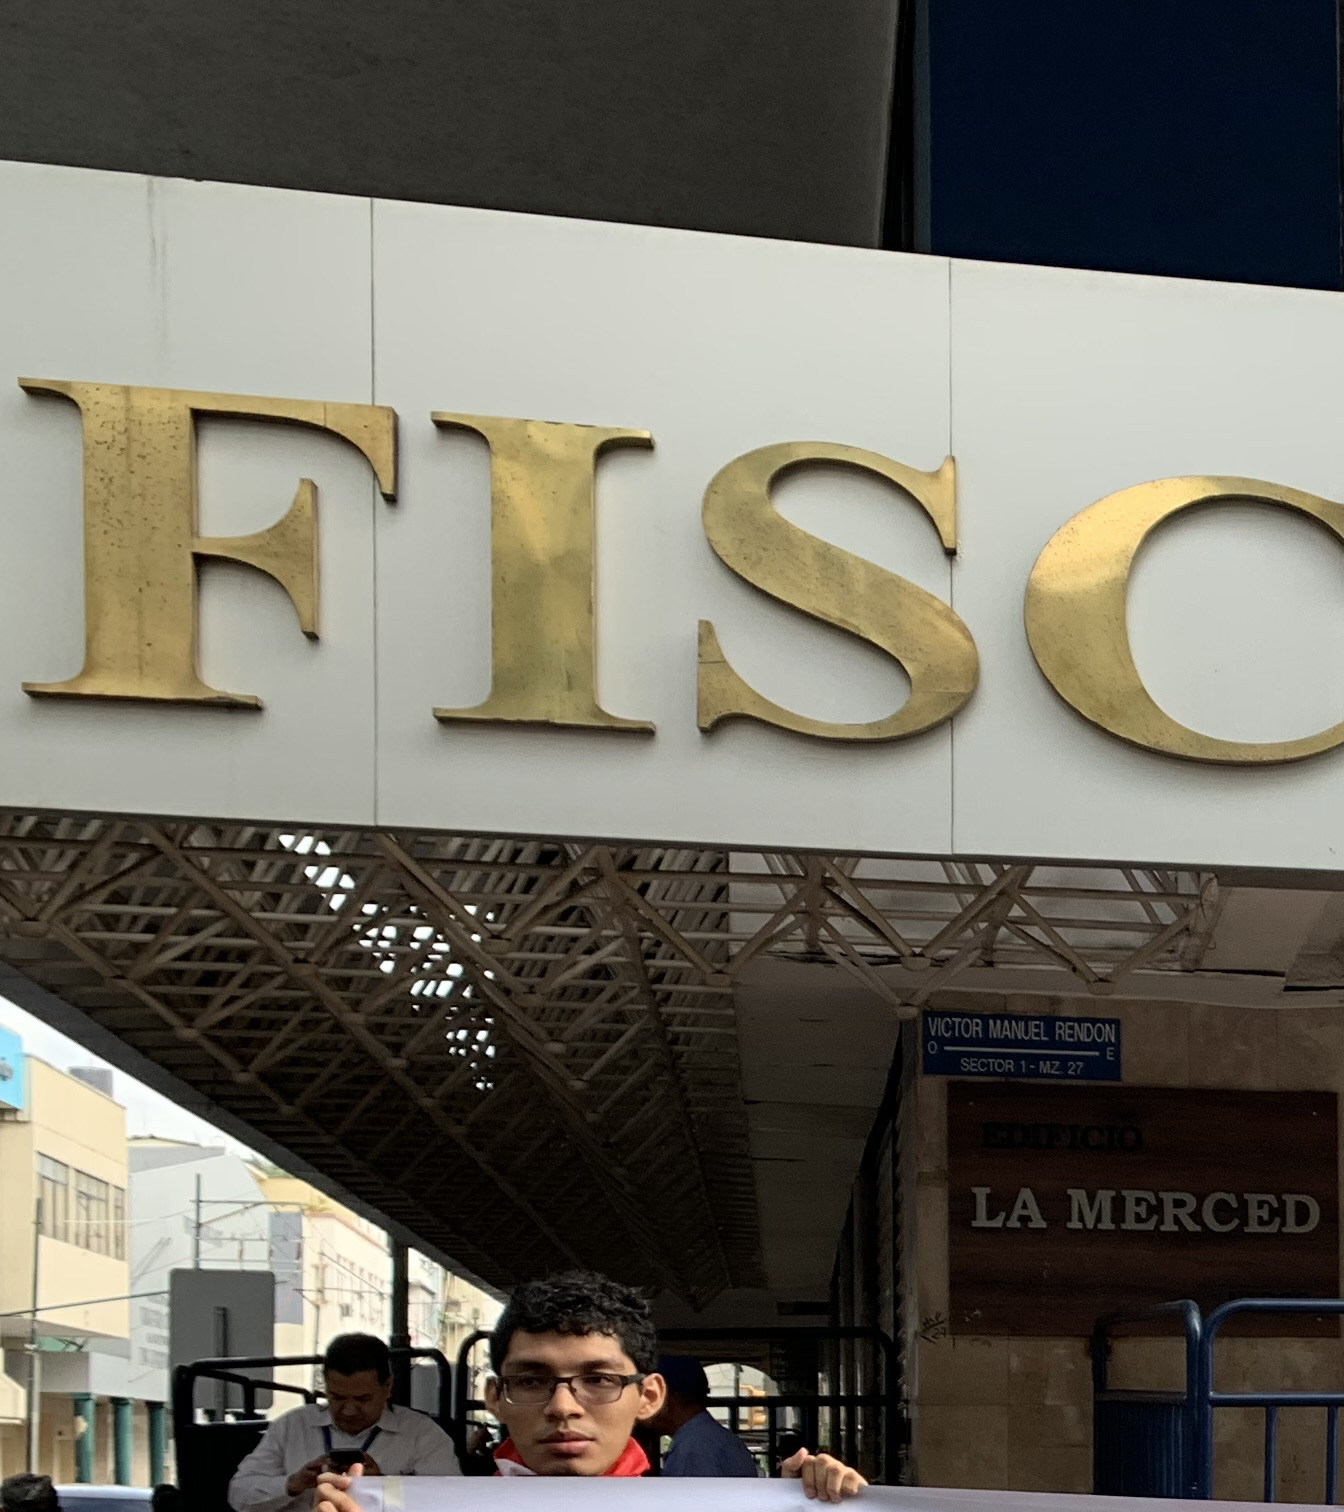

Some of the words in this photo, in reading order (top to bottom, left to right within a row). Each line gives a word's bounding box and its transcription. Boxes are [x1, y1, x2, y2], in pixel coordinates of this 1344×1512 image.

[928, 1017, 982, 1038] VICTOR
[989, 1019, 1049, 1040] MANUEL
[1055, 1021, 1116, 1043] RENDON
[927, 1041, 938, 1054] O
[1106, 1047, 1115, 1060] E
[960, 1058, 1014, 1073] SECTOR
[1020, 1060, 1026, 1072] 1
[1067, 1062, 1084, 1075] 27
[981, 1121, 1144, 1152] EDIFICIO
[970, 1187, 1048, 1229] LA
[1066, 1188, 1321, 1233] MERCED
